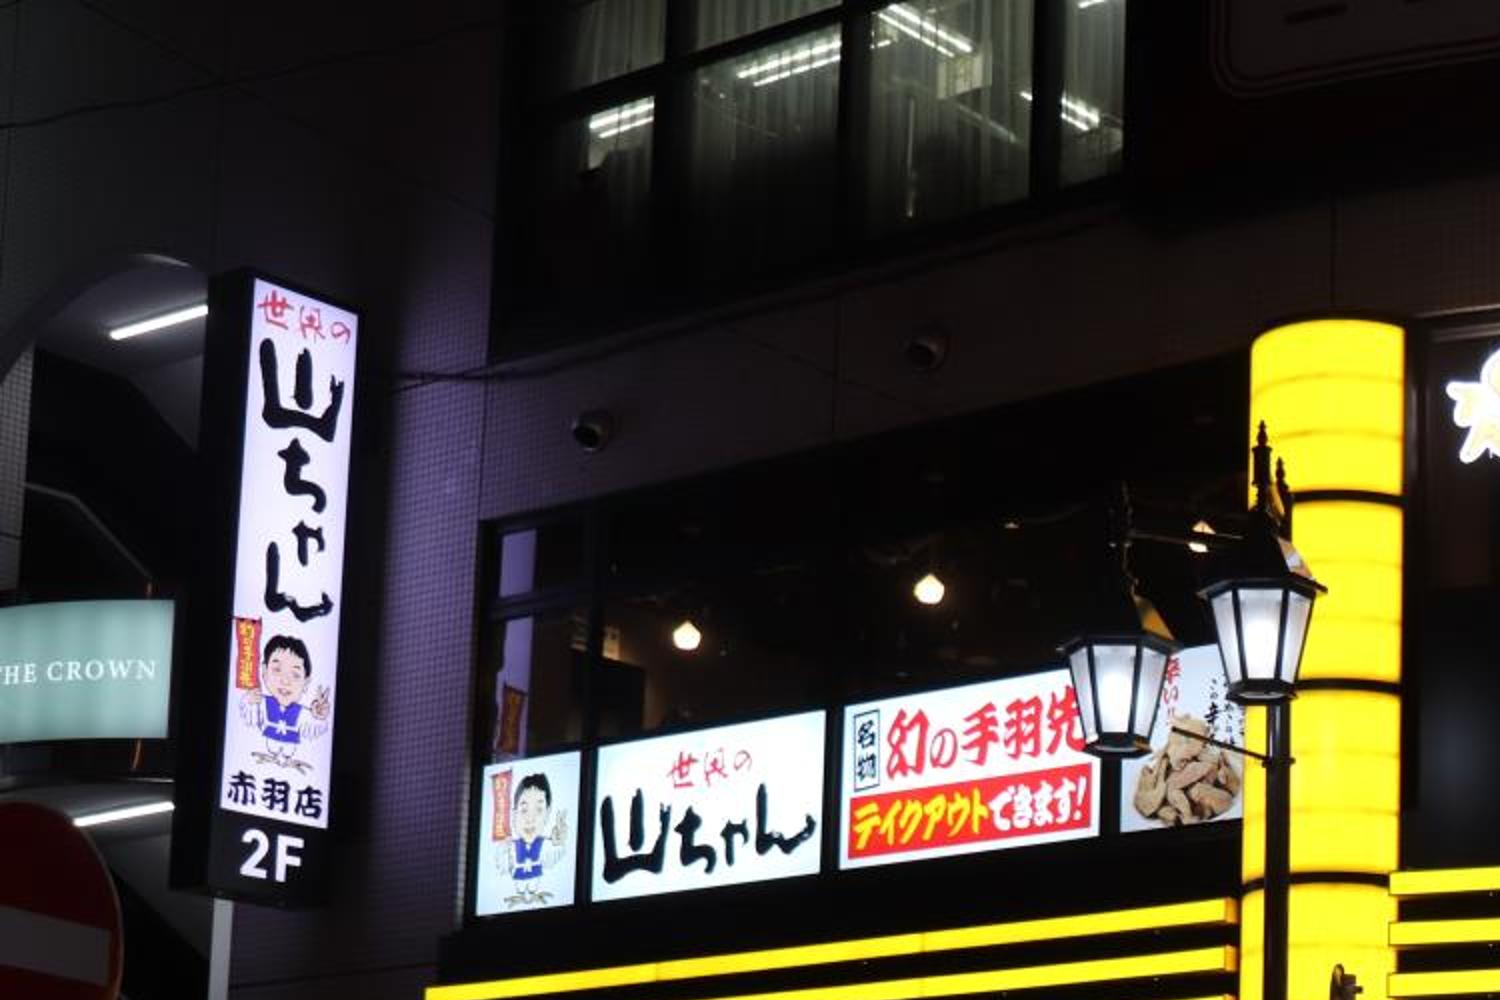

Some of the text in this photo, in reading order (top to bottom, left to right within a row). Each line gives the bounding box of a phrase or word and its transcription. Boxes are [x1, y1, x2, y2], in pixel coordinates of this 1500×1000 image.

[259, 338, 345, 623] 山ちゃん
[0, 659, 157, 685] HE CROWN
[856, 719, 878, 781] 名物
[886, 684, 1087, 780] 幻の手羽先
[227, 771, 323, 820] 赤羽店
[852, 776, 1088, 850] テイクアウトできます!
[239, 829, 304, 883] 2F
[600, 782, 817, 884] 山ちゃん
